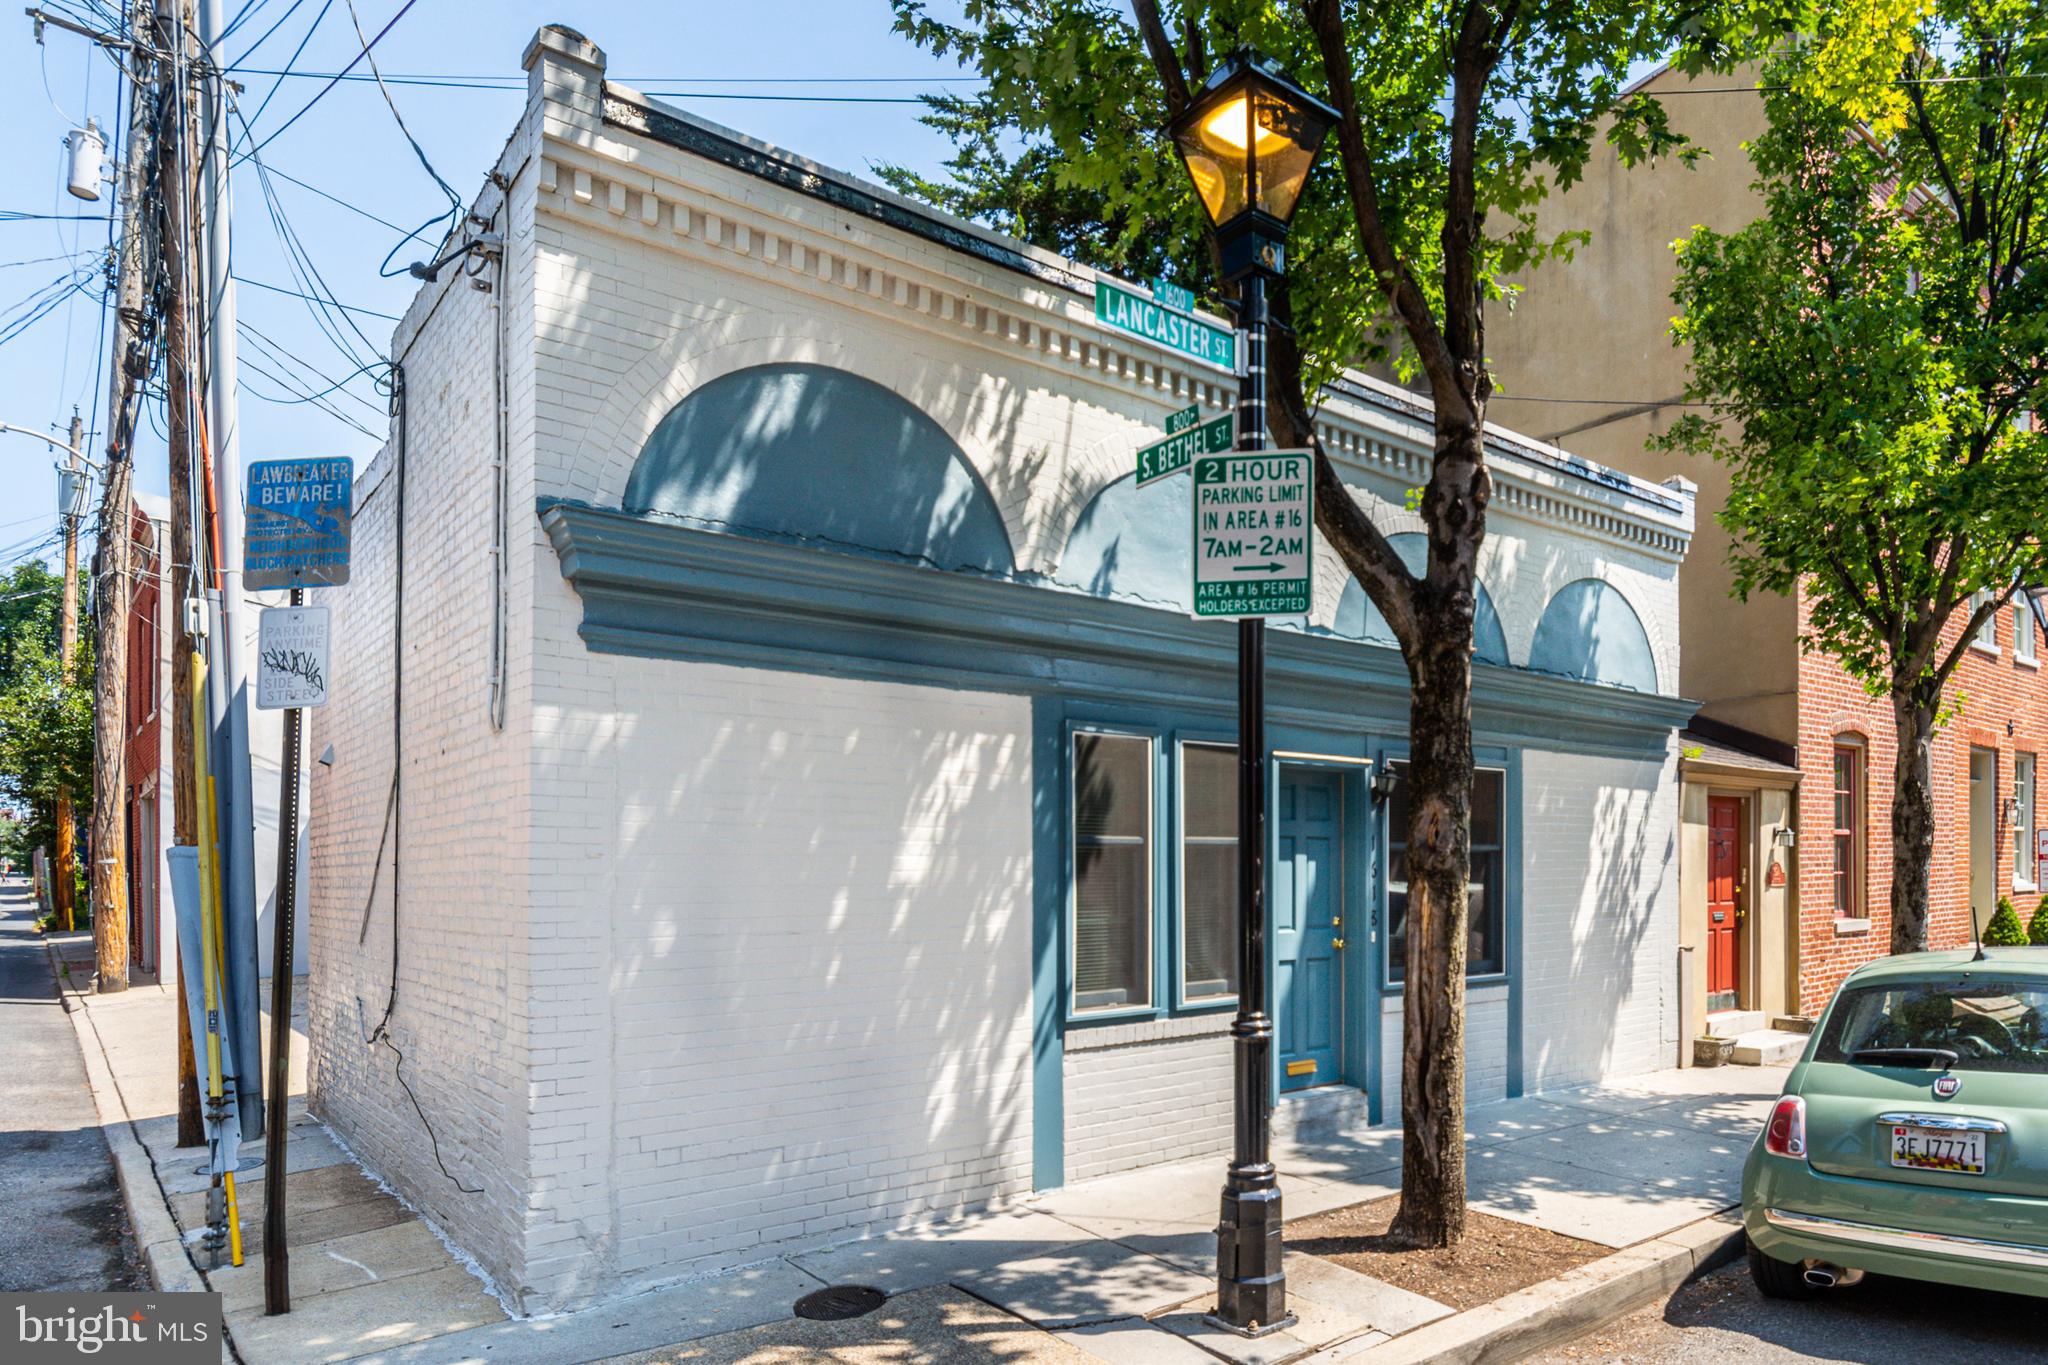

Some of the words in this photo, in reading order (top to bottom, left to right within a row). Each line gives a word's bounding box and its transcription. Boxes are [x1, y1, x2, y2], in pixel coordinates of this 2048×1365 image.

[1164, 283, 1186, 309] 1600
[1105, 288, 1210, 357] LANCASTER
[1215, 338, 1229, 359] ST.
[1173, 409, 1190, 431] 800
[1142, 452, 1154, 478] S.
[1158, 428, 1210, 472] BETHEL
[1215, 424, 1230, 444] ST.
[251, 462, 349, 485] LAWBREAKER
[1205, 461, 1219, 482] 2
[1231, 460, 1300, 482] HOUR
[1202, 486, 1264, 505] PARKING
[1269, 484, 1304, 502] LIMIT
[1203, 511, 1218, 531] IN
[1225, 509, 1269, 530] AREA
[1198, 583, 1232, 597] AREA
[1263, 581, 1307, 595] PERMIT
[1199, 599, 1248, 613] HOLDERS
[1251, 597, 1306, 612] EXCEPTED
[287, 613, 304, 625] NO
[265, 624, 324, 639] PARKING
[266, 636, 322, 649] ANYTIME
[264, 676, 294, 689] SIDE
[1938, 1080, 1956, 1091] FIAT
